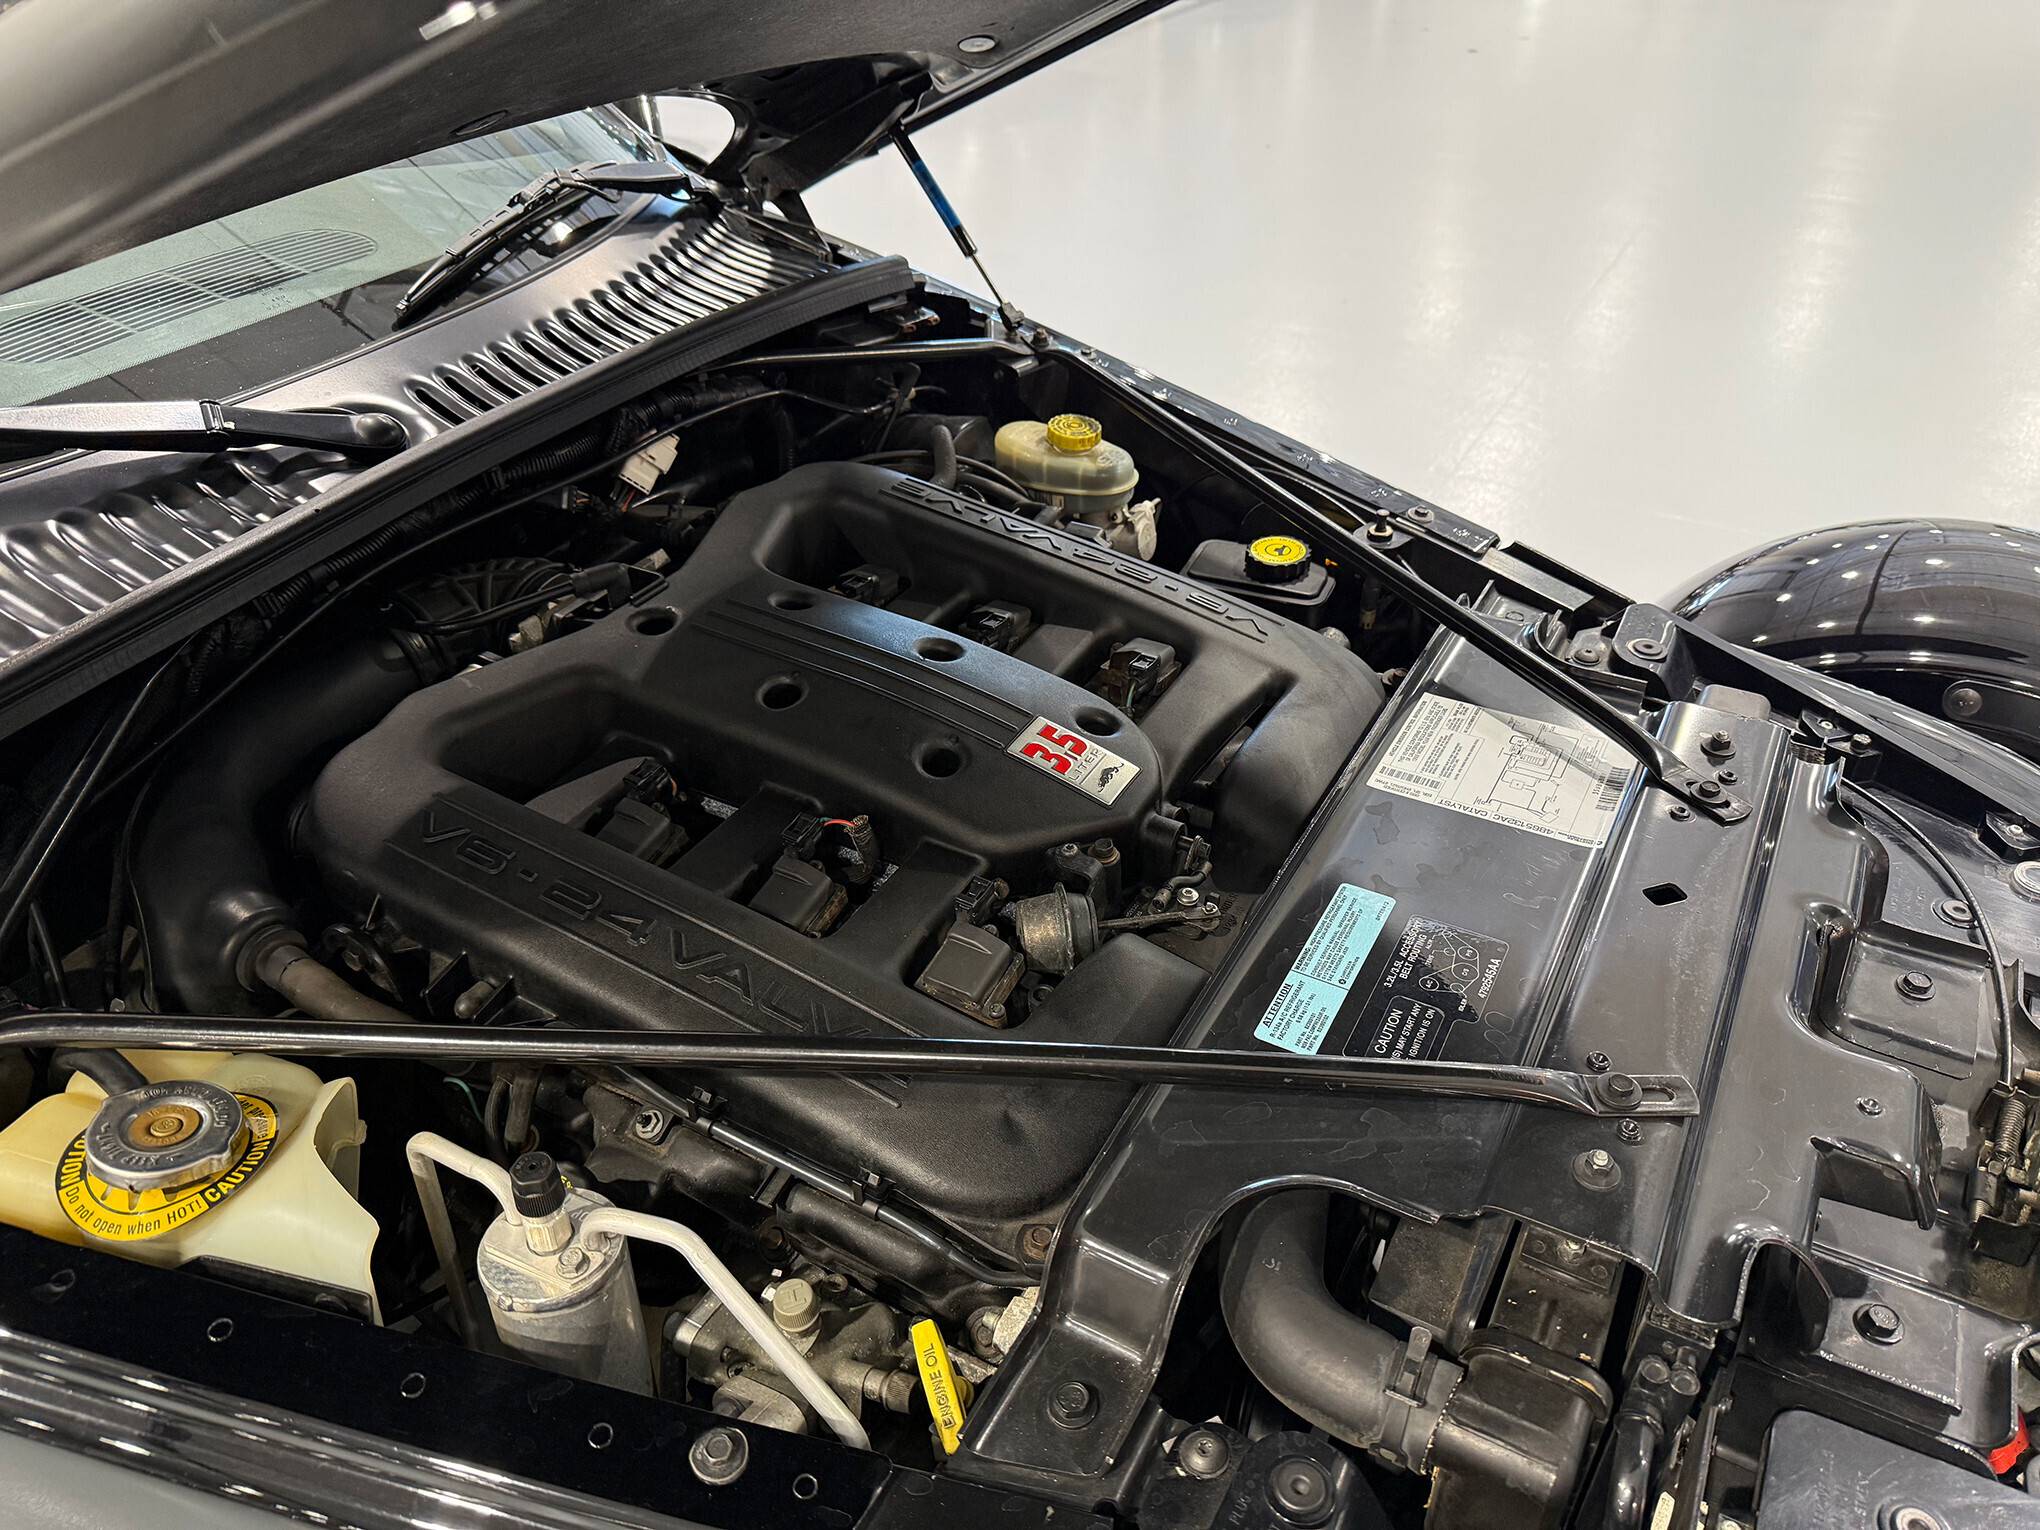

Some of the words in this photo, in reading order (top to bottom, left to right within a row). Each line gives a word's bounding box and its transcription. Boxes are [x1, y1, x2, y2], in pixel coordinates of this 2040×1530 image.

[1068, 748, 1104, 781] LITER
[1437, 799, 1488, 817] CATALYST
[1384, 960, 1404, 988] 3.2L/3.5L
[1400, 921, 1423, 958] ACCESSORY
[1399, 962, 1413, 979] BELT
[1408, 934, 1427, 963] ROUTING
[1279, 1012, 1288, 1022] A/C
[1284, 981, 1305, 1013] REFRIGERANT
[1478, 959, 1502, 999] 4792545AA
[1263, 984, 1291, 1026] ATTENTION
[1277, 1019, 1293, 1041] FACTORY
[1290, 999, 1305, 1019] CHARGE
[1396, 1036, 1407, 1050] MAY
[1402, 1016, 1416, 1036] START
[1411, 1003, 1422, 1017] ANY
[1374, 1008, 1403, 1053] CAUTION
[1409, 1028, 1427, 1057] IGNITION
[1425, 1009, 1436, 1019] ON
[61, 1137, 87, 1187] UTION
[204, 1139, 270, 1203] CAUTION
[66, 1186, 79, 1204] Do
[74, 1203, 92, 1223] not
[92, 1216, 123, 1236] open
[127, 1219, 161, 1236] when
[166, 1200, 203, 1225] HOT!
[923, 1343, 939, 1367] OIL
[929, 1370, 957, 1429] ENGINE
